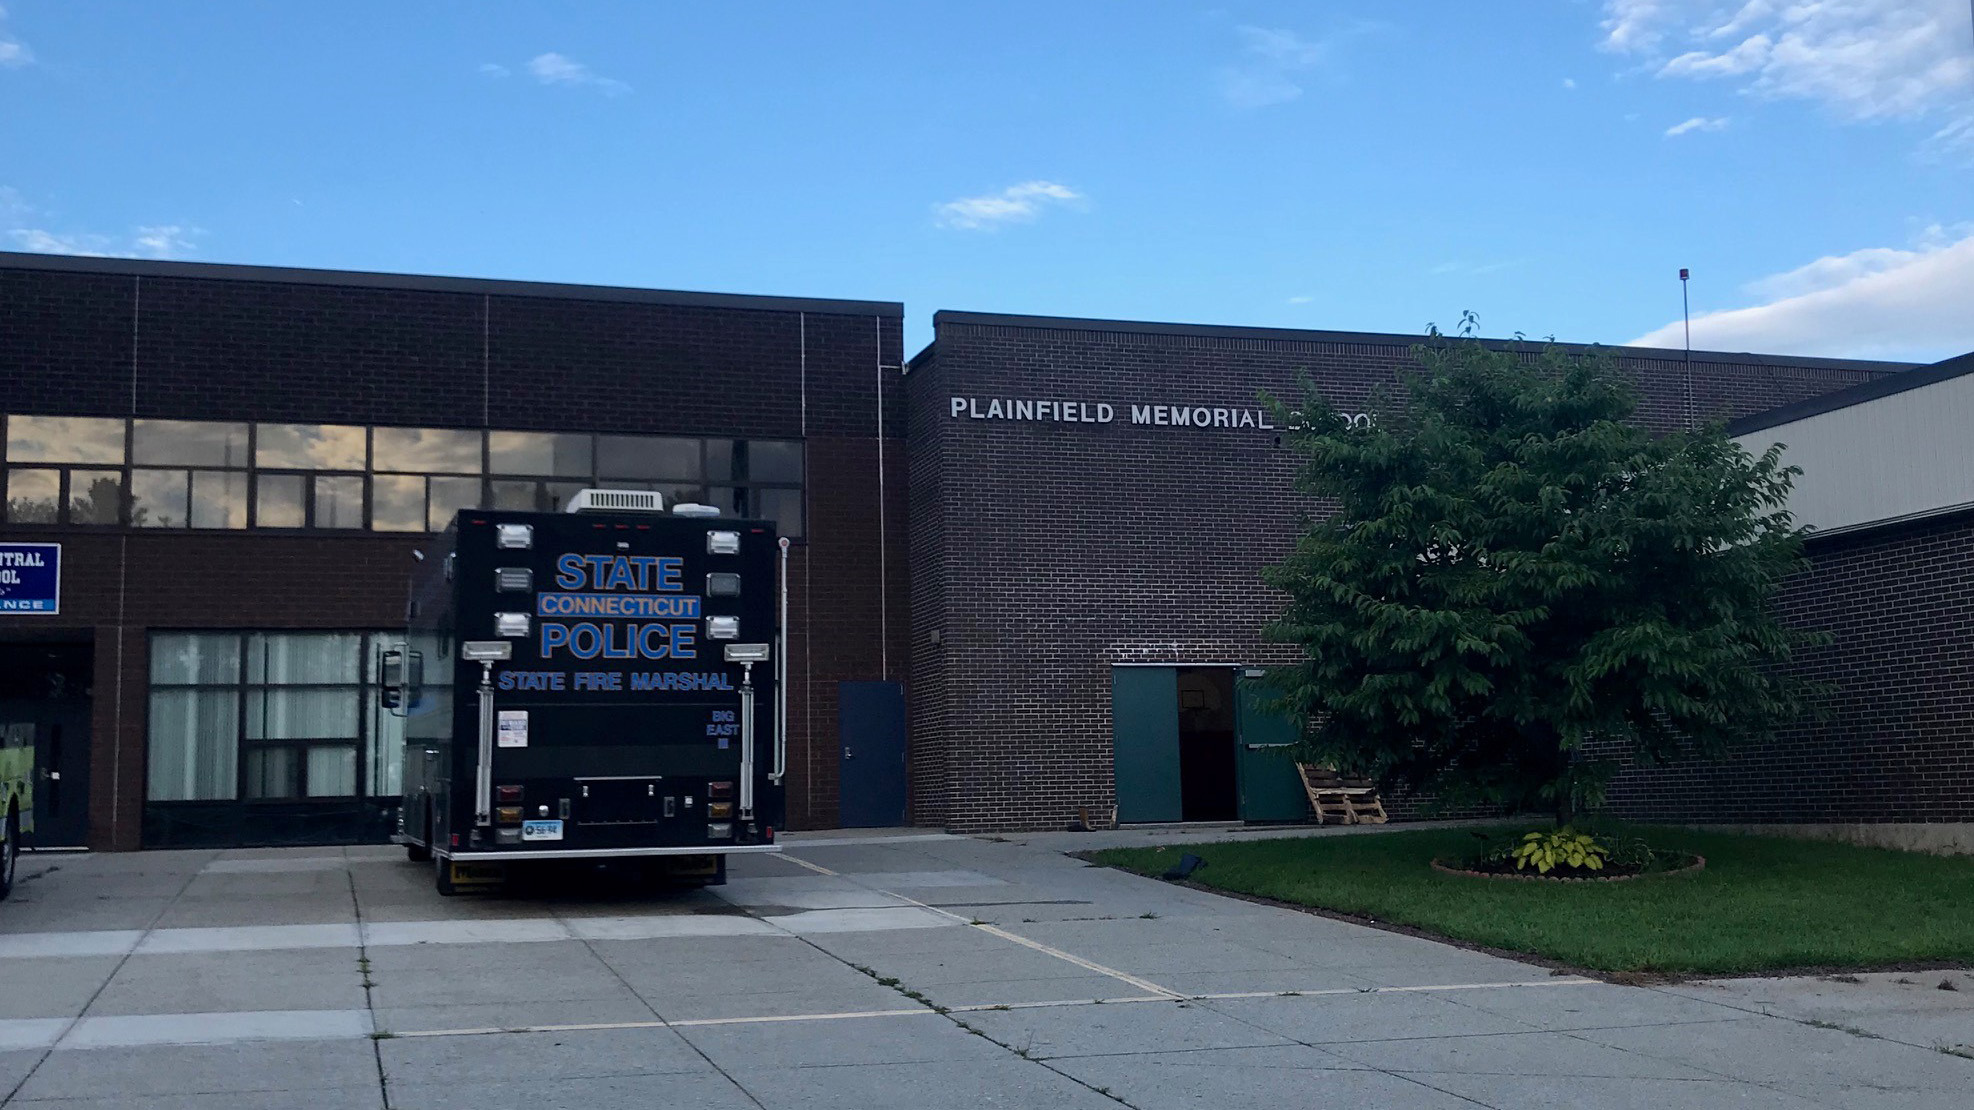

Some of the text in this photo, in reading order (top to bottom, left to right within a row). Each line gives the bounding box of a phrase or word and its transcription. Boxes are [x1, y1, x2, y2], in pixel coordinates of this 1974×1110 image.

[951, 397, 1114, 424] PLAINFIELD
[1131, 404, 1274, 431] MEMORIAL
[0, 569, 20, 584] OL
[556, 553, 684, 591] STATE
[0, 600, 44, 609] NCE
[541, 596, 697, 615] CONNECTICUT
[540, 622, 697, 659] POLICE
[499, 671, 734, 691] STATE FIRE MARSHAL
[712, 710, 735, 722] BIG
[706, 724, 740, 736] EAST
